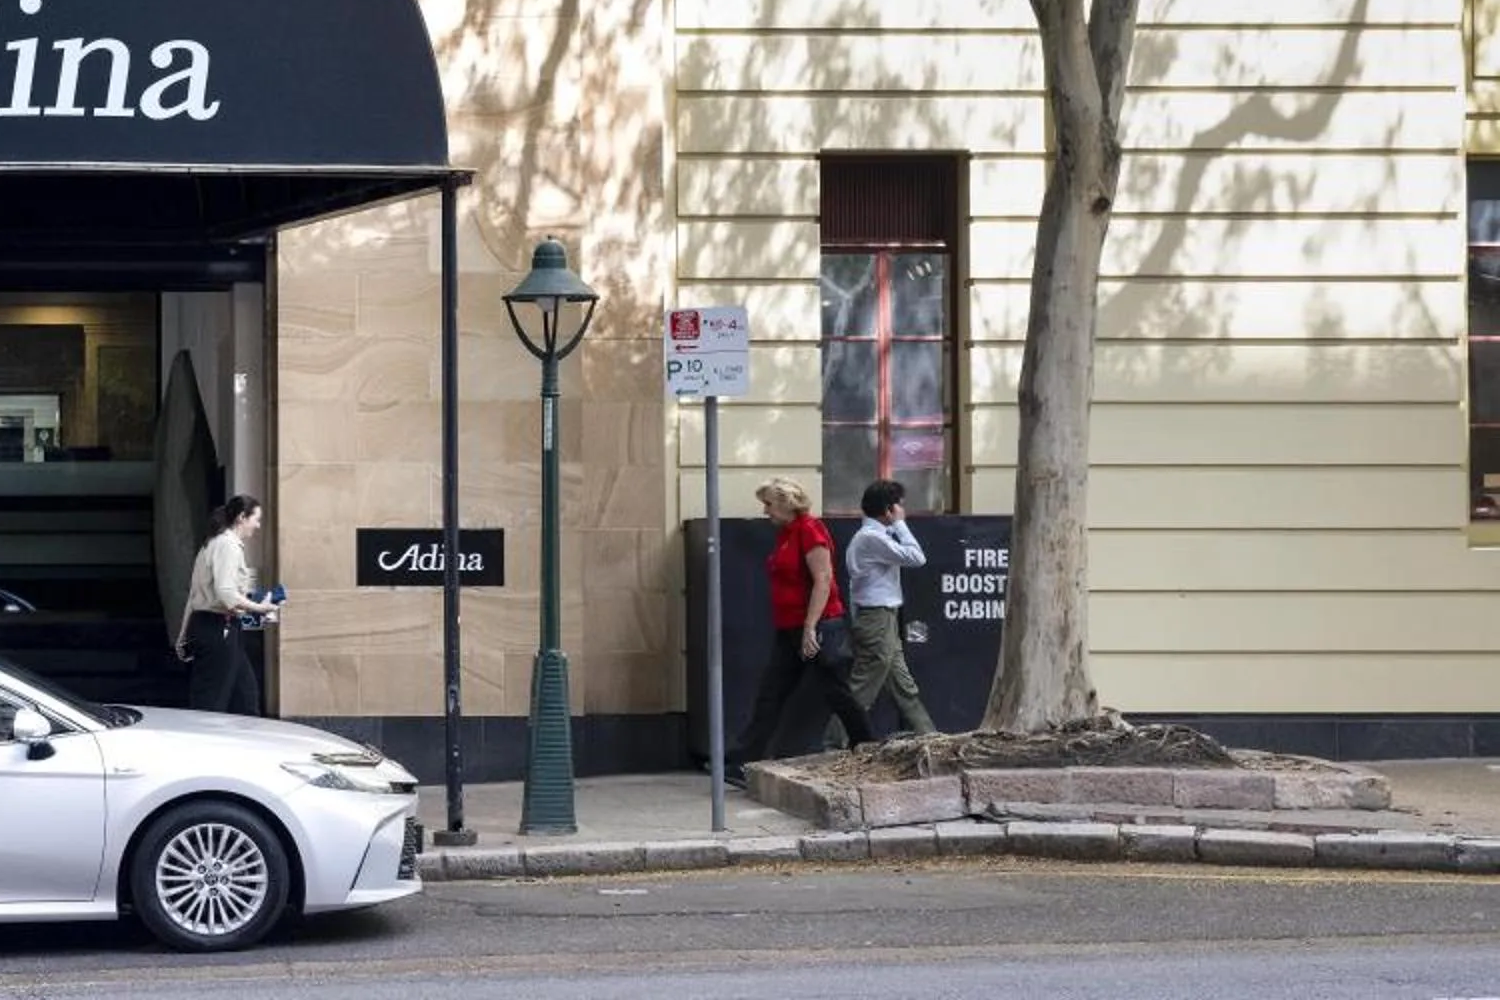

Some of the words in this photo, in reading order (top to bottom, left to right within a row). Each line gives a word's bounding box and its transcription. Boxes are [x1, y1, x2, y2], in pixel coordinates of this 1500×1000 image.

[964, 549, 1009, 568] FIRE
[941, 574, 1008, 593] BOOST
[944, 600, 1005, 619] CABIN
